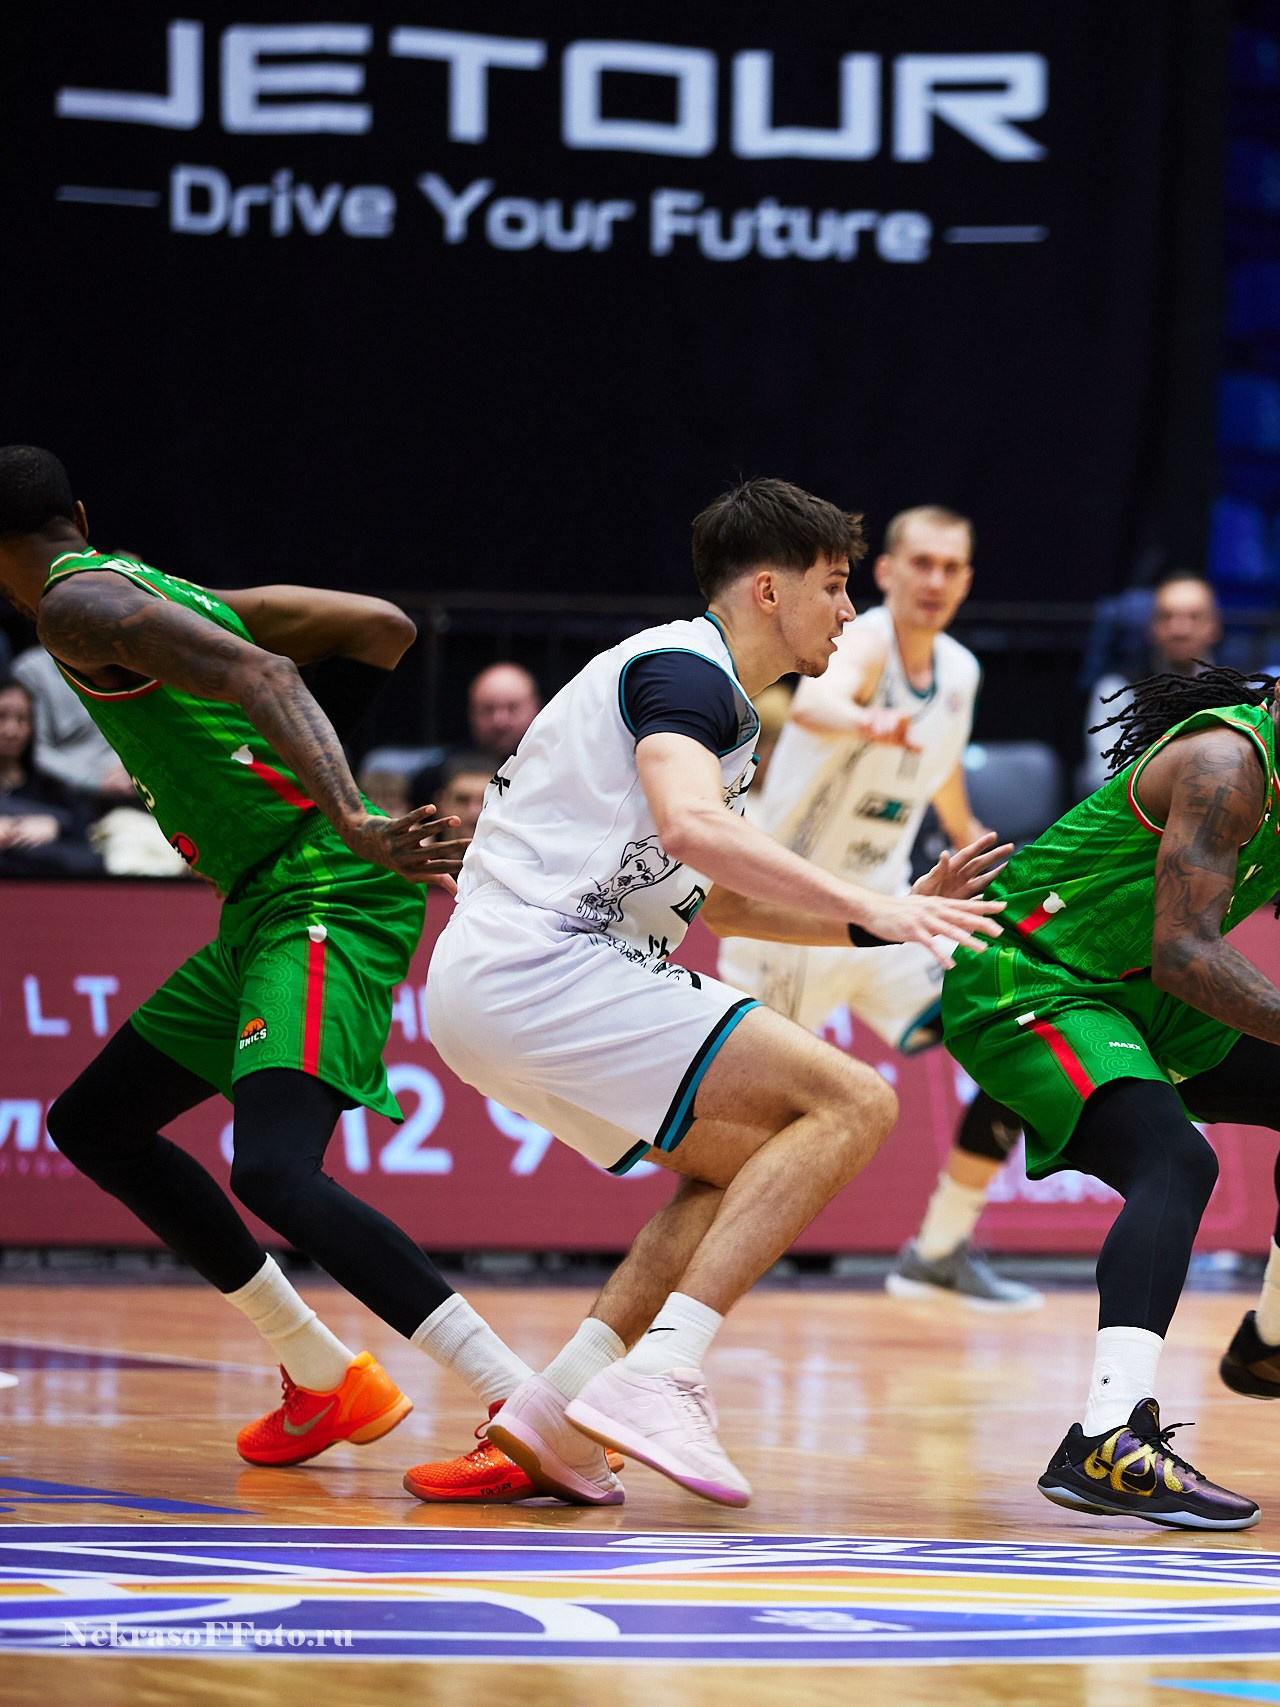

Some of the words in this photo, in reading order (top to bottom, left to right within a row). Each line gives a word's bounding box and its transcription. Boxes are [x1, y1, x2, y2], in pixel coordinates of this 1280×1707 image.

[56, 19, 1050, 163] JETOUR
[168, 165, 397, 237] Drive
[417, 172, 636, 252] Your
[649, 186, 932, 262] Future
[239, 1028, 267, 1050] UNICS
